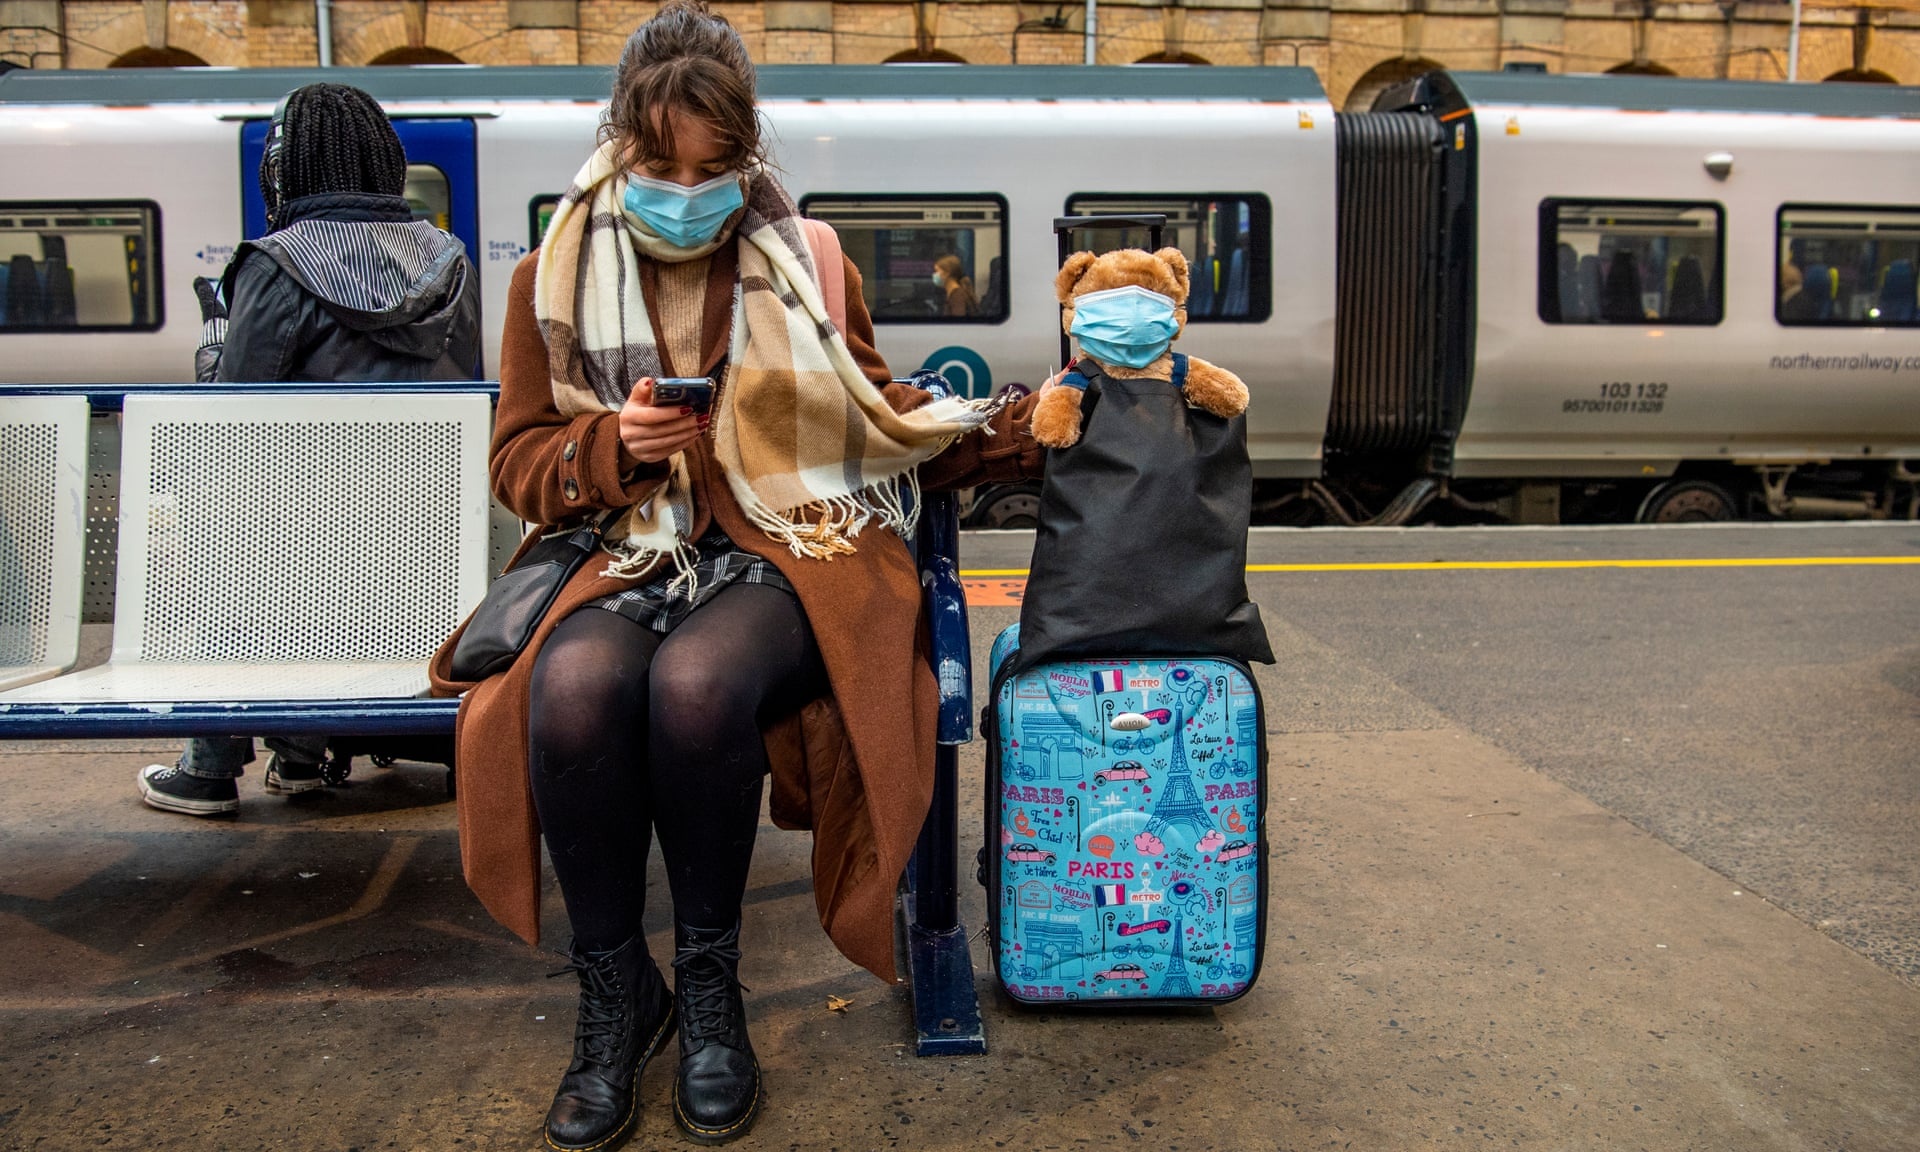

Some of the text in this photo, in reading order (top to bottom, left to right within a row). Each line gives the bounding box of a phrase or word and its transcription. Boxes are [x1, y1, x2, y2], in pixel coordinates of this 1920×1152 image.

[489, 240, 516, 250] Seats
[1601, 382, 1668, 398] 103 132
[1049, 672, 1089, 687] MOULIN
[1130, 679, 1159, 688] METRO
[1059, 683, 1091, 696] Rouge
[1118, 720, 1142, 728] AVION
[1190, 732, 1222, 745] La tour
[1192, 748, 1215, 762] Eiffel
[1068, 861, 1134, 879] PARIS
[1053, 883, 1091, 901] MOULIN
[1131, 894, 1161, 902] METRO
[1061, 895, 1093, 909] Rouge
[1189, 941, 1219, 952] La tour
[1189, 955, 1213, 965] Eiffel
[1006, 983, 1064, 998] ARIS
